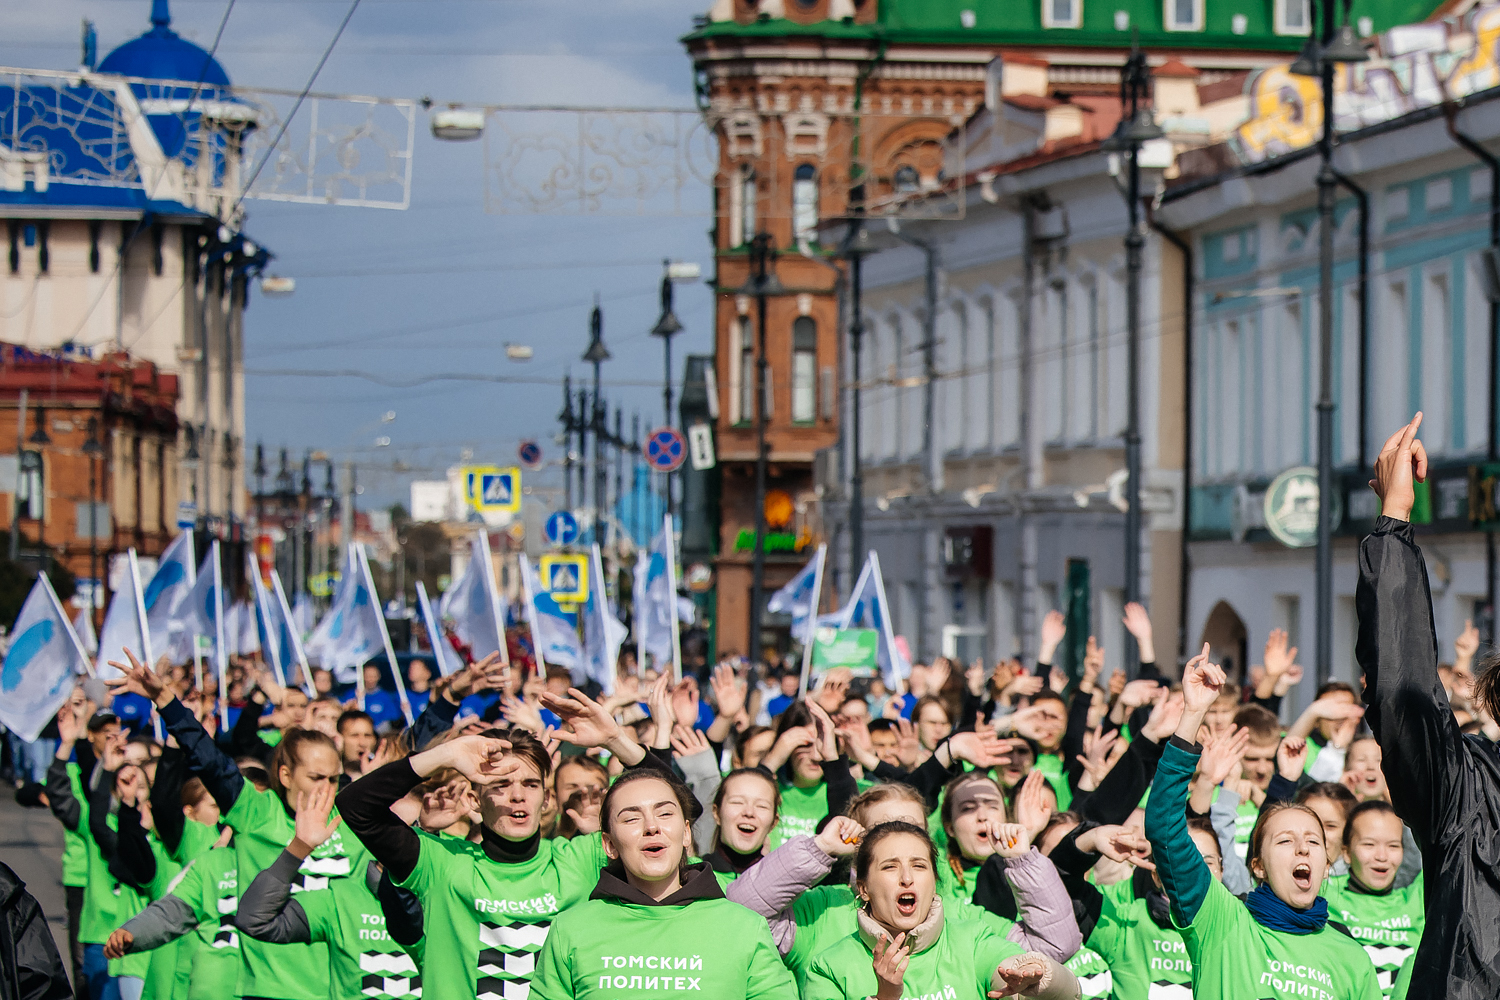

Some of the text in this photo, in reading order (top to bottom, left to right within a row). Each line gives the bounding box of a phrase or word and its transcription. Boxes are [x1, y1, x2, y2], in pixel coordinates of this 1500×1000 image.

[1347, 926, 1409, 941] ОЛИТЕХ
[601, 954, 703, 971] ТОМСКИЙ
[599, 975, 702, 991] ПОЛИТЕХ
